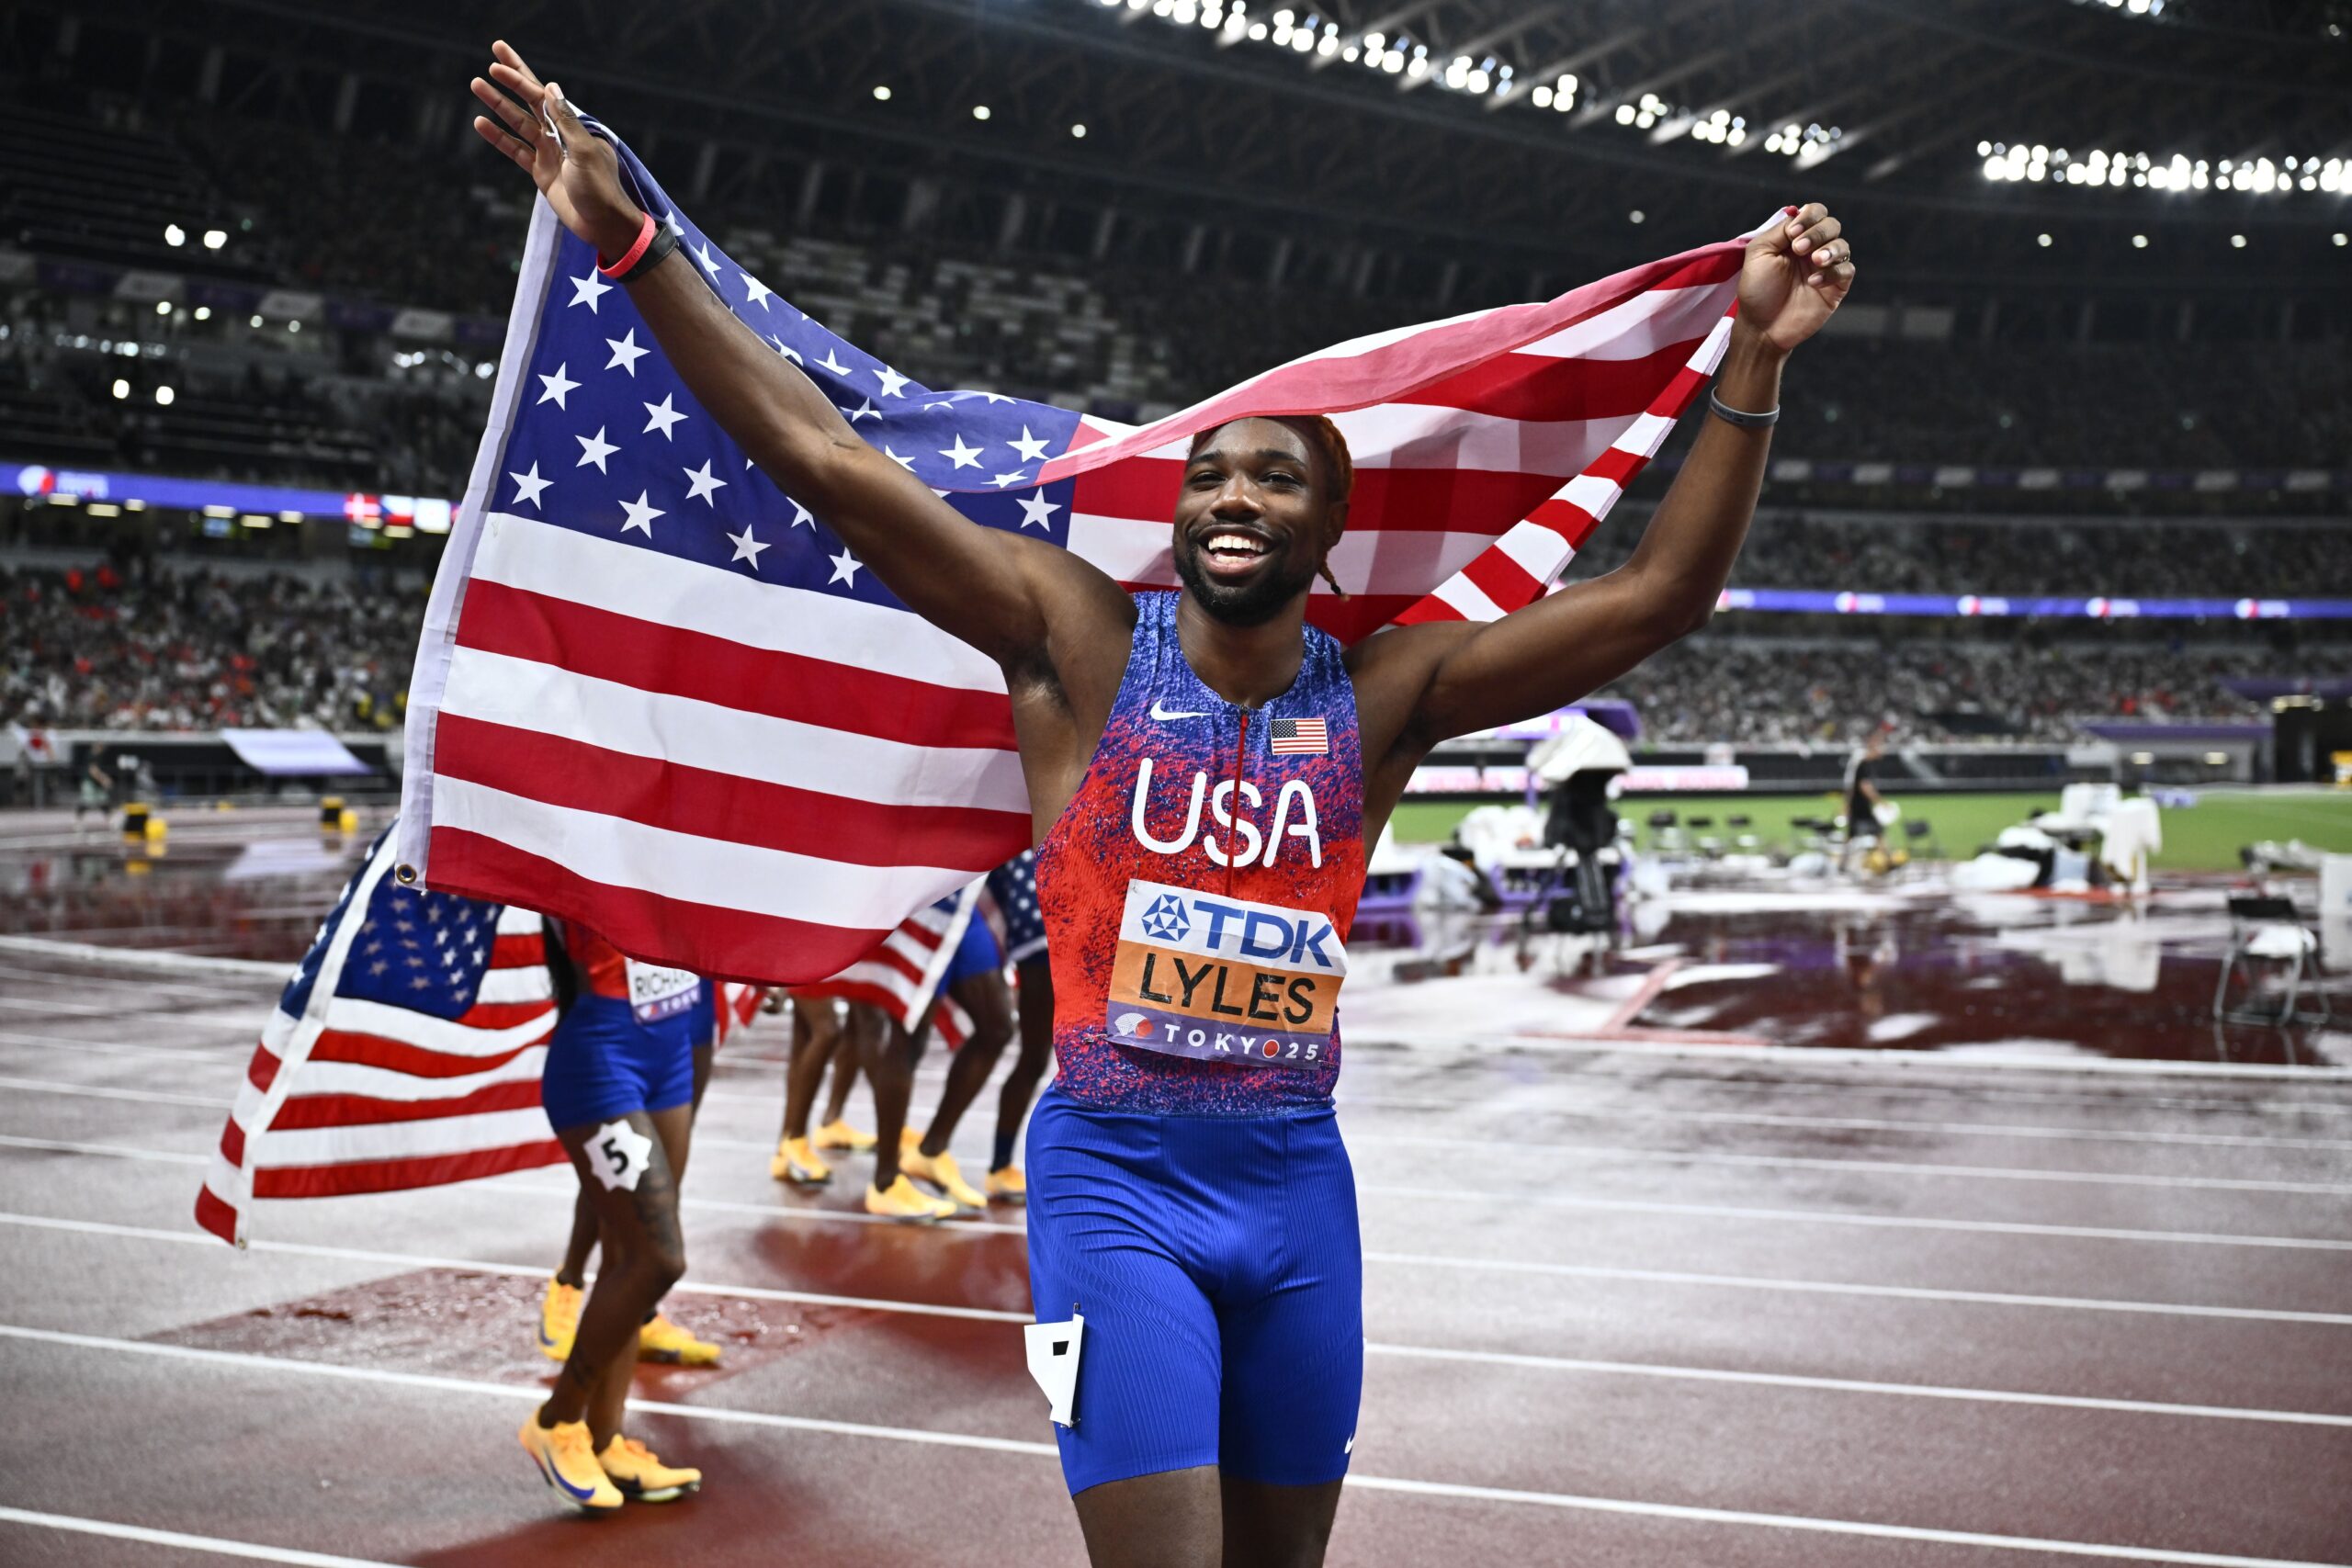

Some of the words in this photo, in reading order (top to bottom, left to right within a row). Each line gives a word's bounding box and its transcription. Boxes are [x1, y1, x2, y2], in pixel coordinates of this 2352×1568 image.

[1131, 758, 1322, 868] USA
[1193, 899, 1333, 968] TDK
[1138, 953, 1317, 1025] LYLES
[602, 1136, 629, 1176] 5
